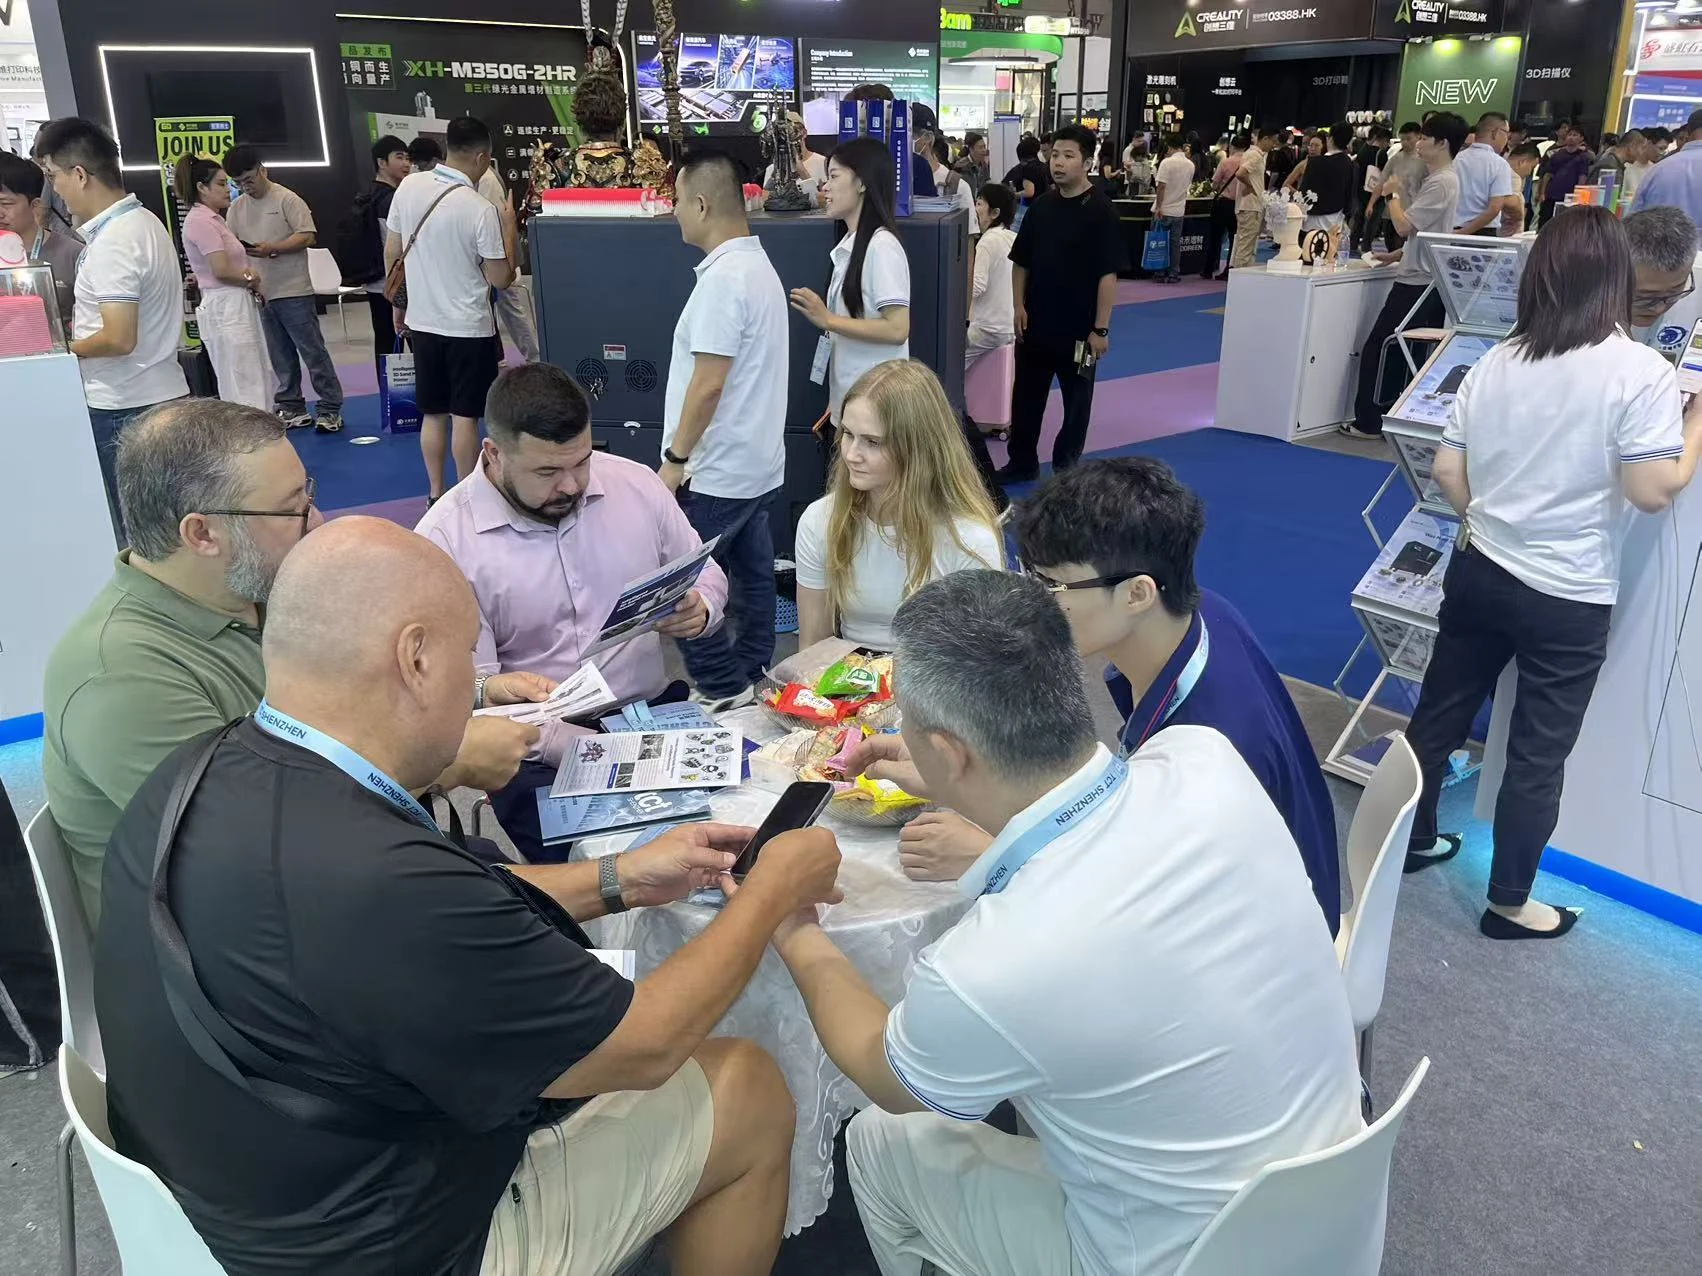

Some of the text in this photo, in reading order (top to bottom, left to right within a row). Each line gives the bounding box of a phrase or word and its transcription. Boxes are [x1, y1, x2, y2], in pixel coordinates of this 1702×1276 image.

[1196, 9, 1243, 22] CREALITY
[1268, 8, 1317, 22] 03388.HK
[408, 60, 576, 81] XH-M350G-2HR
[1526, 67, 1571, 79] 3D扫描仪
[1415, 78, 1498, 105] NEW
[161, 135, 233, 160] JOIN US
[261, 710, 307, 740] SHENZHEN
[367, 772, 411, 807] SHENZHEN
[1055, 772, 1117, 826] TCT SHENZHEN
